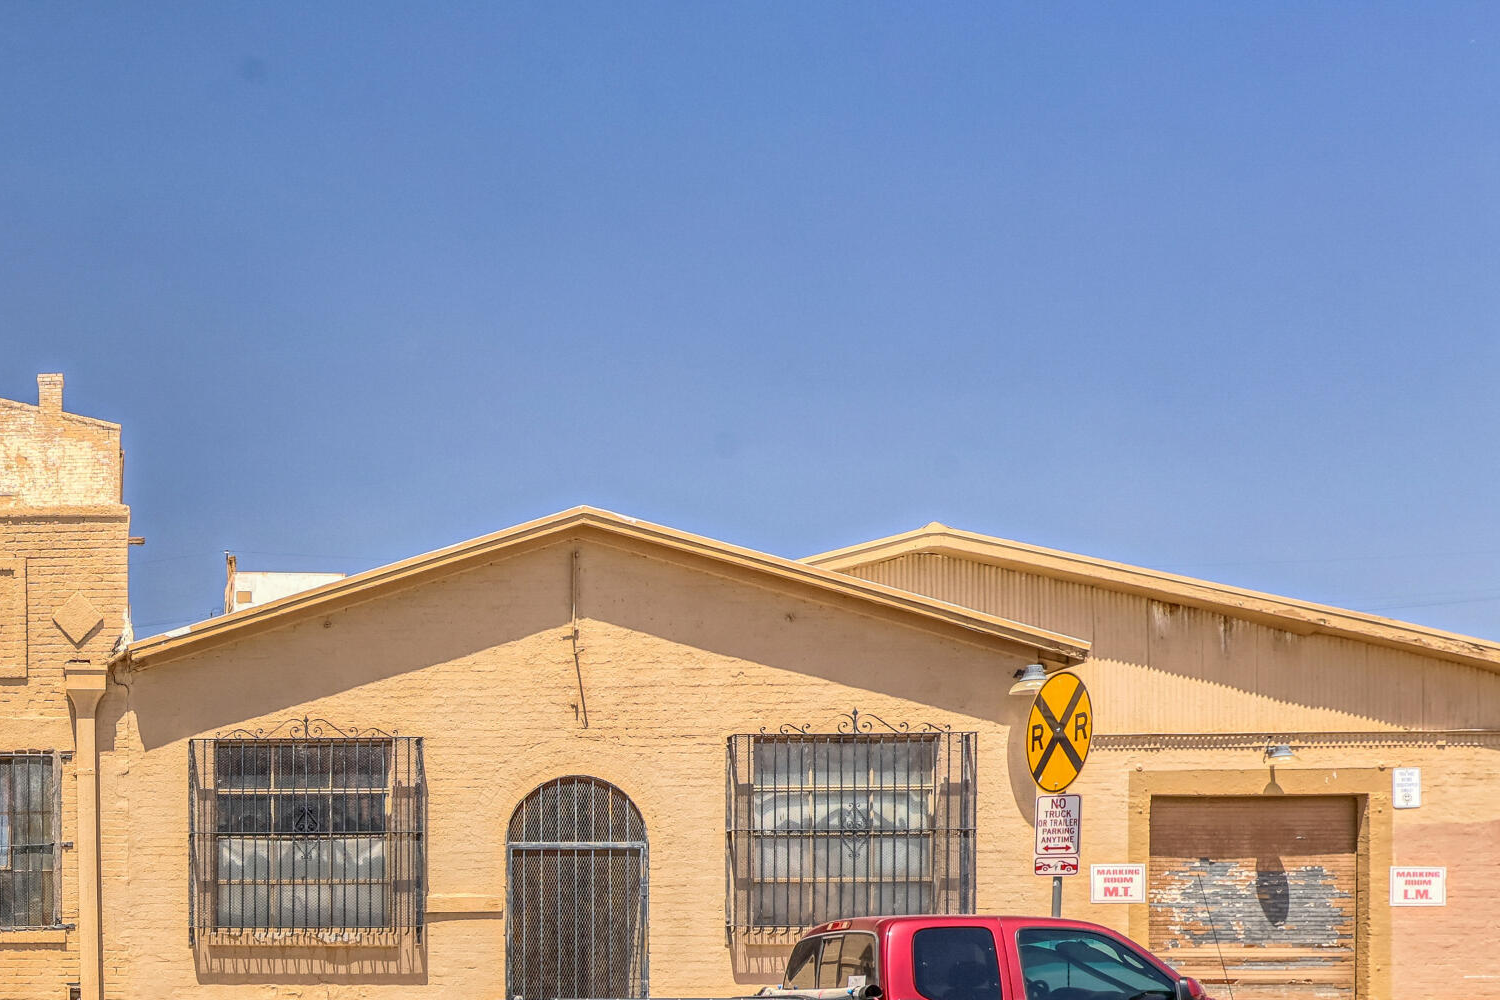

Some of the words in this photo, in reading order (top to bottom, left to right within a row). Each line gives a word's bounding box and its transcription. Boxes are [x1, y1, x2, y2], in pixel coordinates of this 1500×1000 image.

[1031, 724, 1044, 752] R
[1074, 712, 1088, 742] R
[1051, 798, 1067, 809] NO
[1044, 810, 1072, 818] TRUCK
[1050, 819, 1078, 827] TRAILER
[1041, 836, 1074, 844] ANYTIME
[1104, 887, 1133, 897] M.T.
[1404, 889, 1433, 900] L.M.
